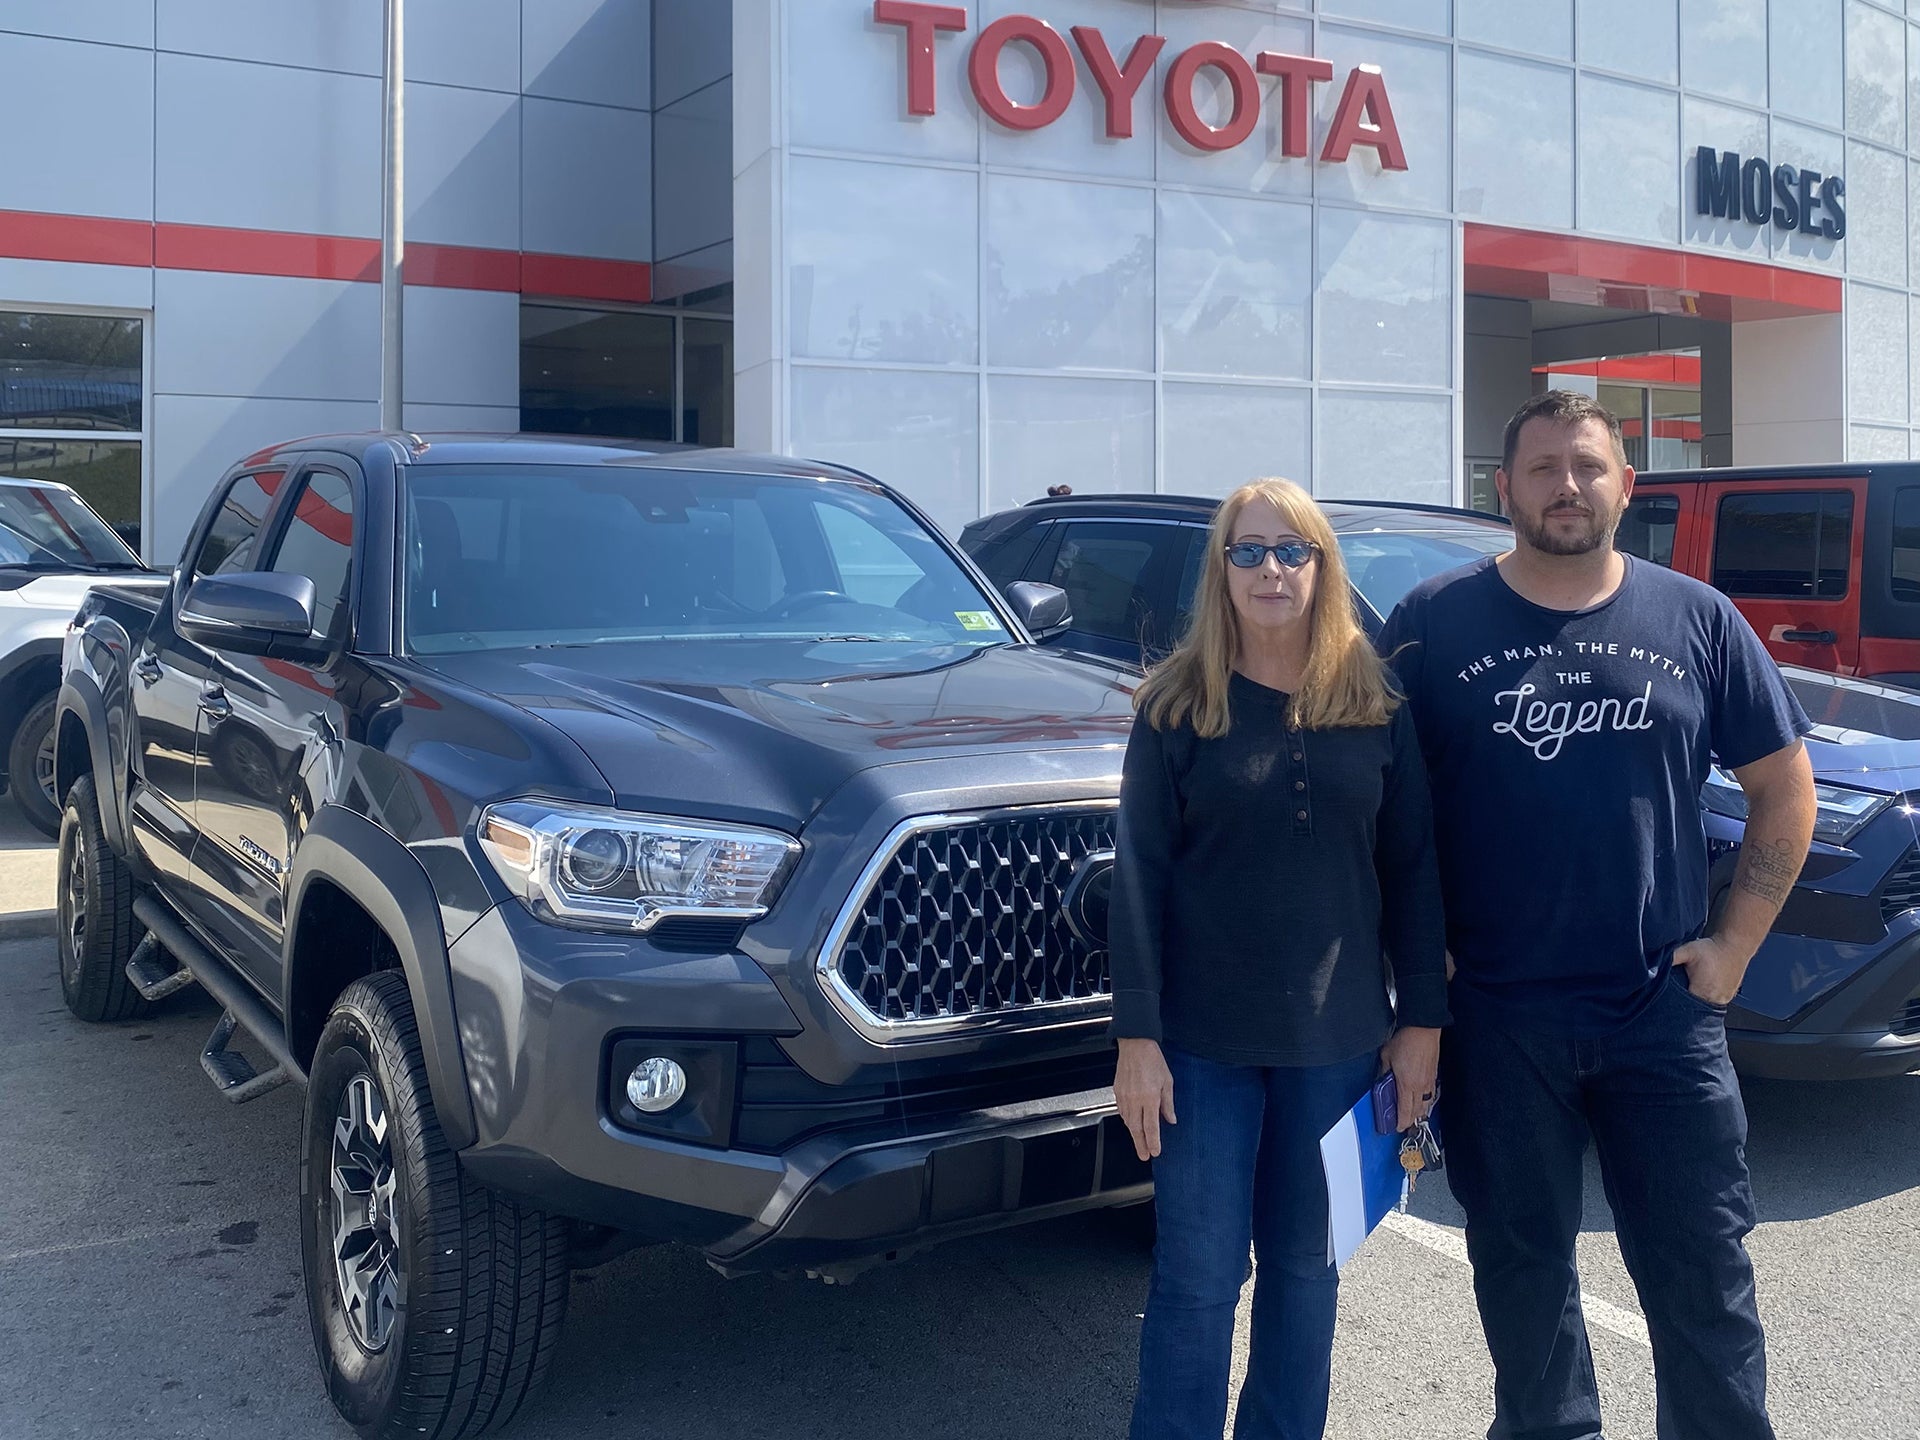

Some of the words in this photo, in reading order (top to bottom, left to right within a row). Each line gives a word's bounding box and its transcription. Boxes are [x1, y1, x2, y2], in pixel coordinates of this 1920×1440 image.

[873, 0, 1409, 171] TOYOTA
[1696, 145, 1846, 241] MOSES
[1457, 654, 1496, 684] THE
[1503, 643, 1564, 662] MAN,
[1574, 641, 1620, 656] THE
[1629, 646, 1687, 681] MYTH
[1555, 671, 1593, 685] THE
[1492, 680, 1654, 761] Legend
